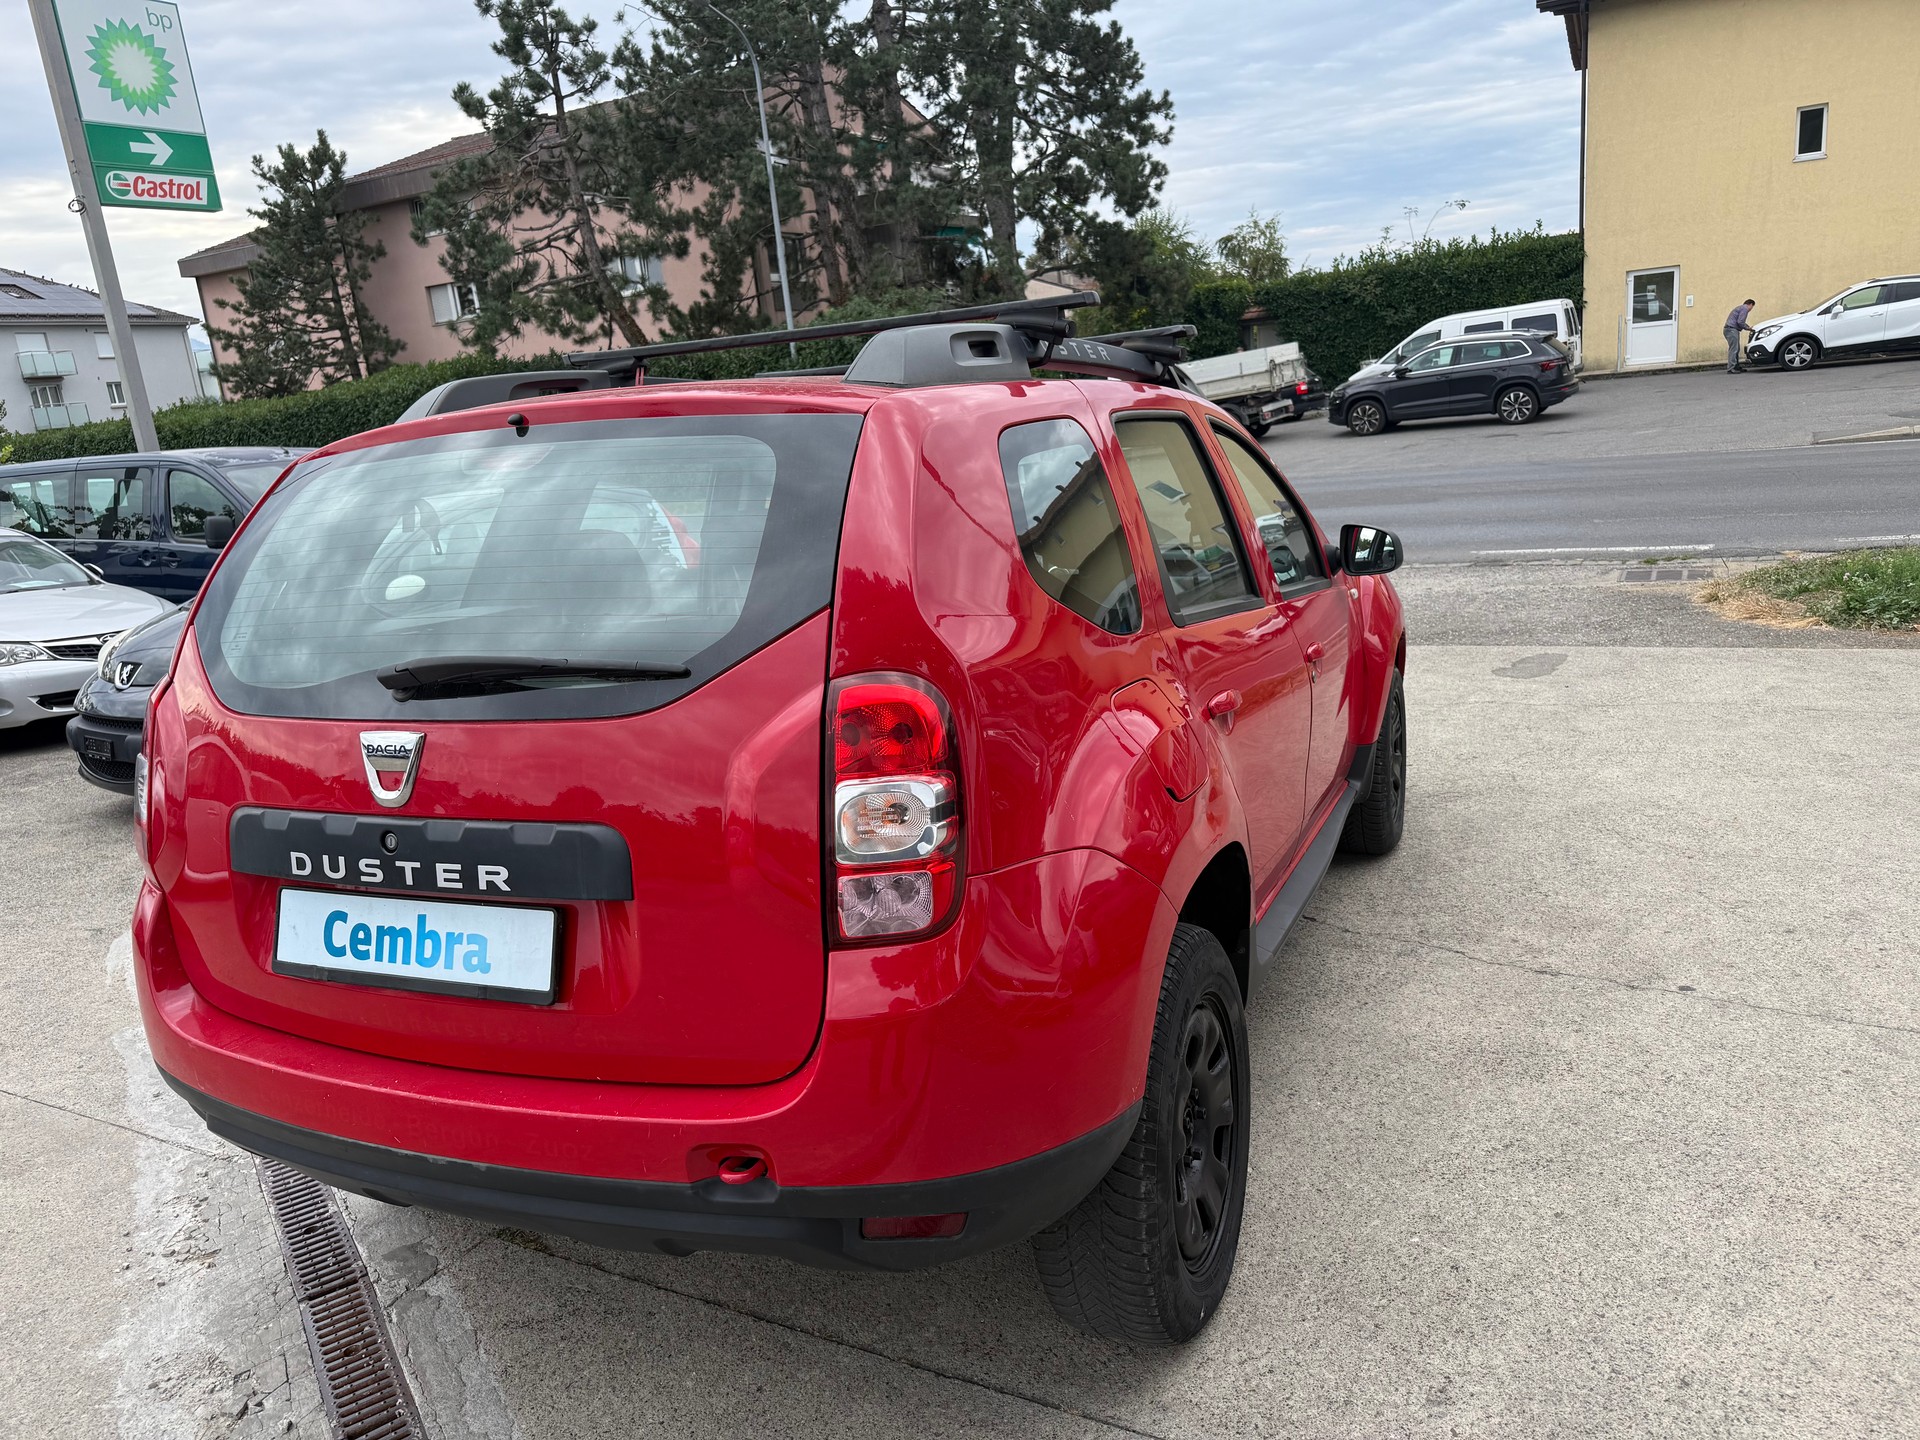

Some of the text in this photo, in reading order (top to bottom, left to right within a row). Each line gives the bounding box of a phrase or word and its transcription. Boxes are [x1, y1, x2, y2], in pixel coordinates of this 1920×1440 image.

[145, 7, 173, 33] bp
[133, 175, 203, 201] Castrol
[366, 744, 409, 755] DACIA
[289, 851, 512, 892] DUSTER
[323, 909, 492, 975] Cembra
